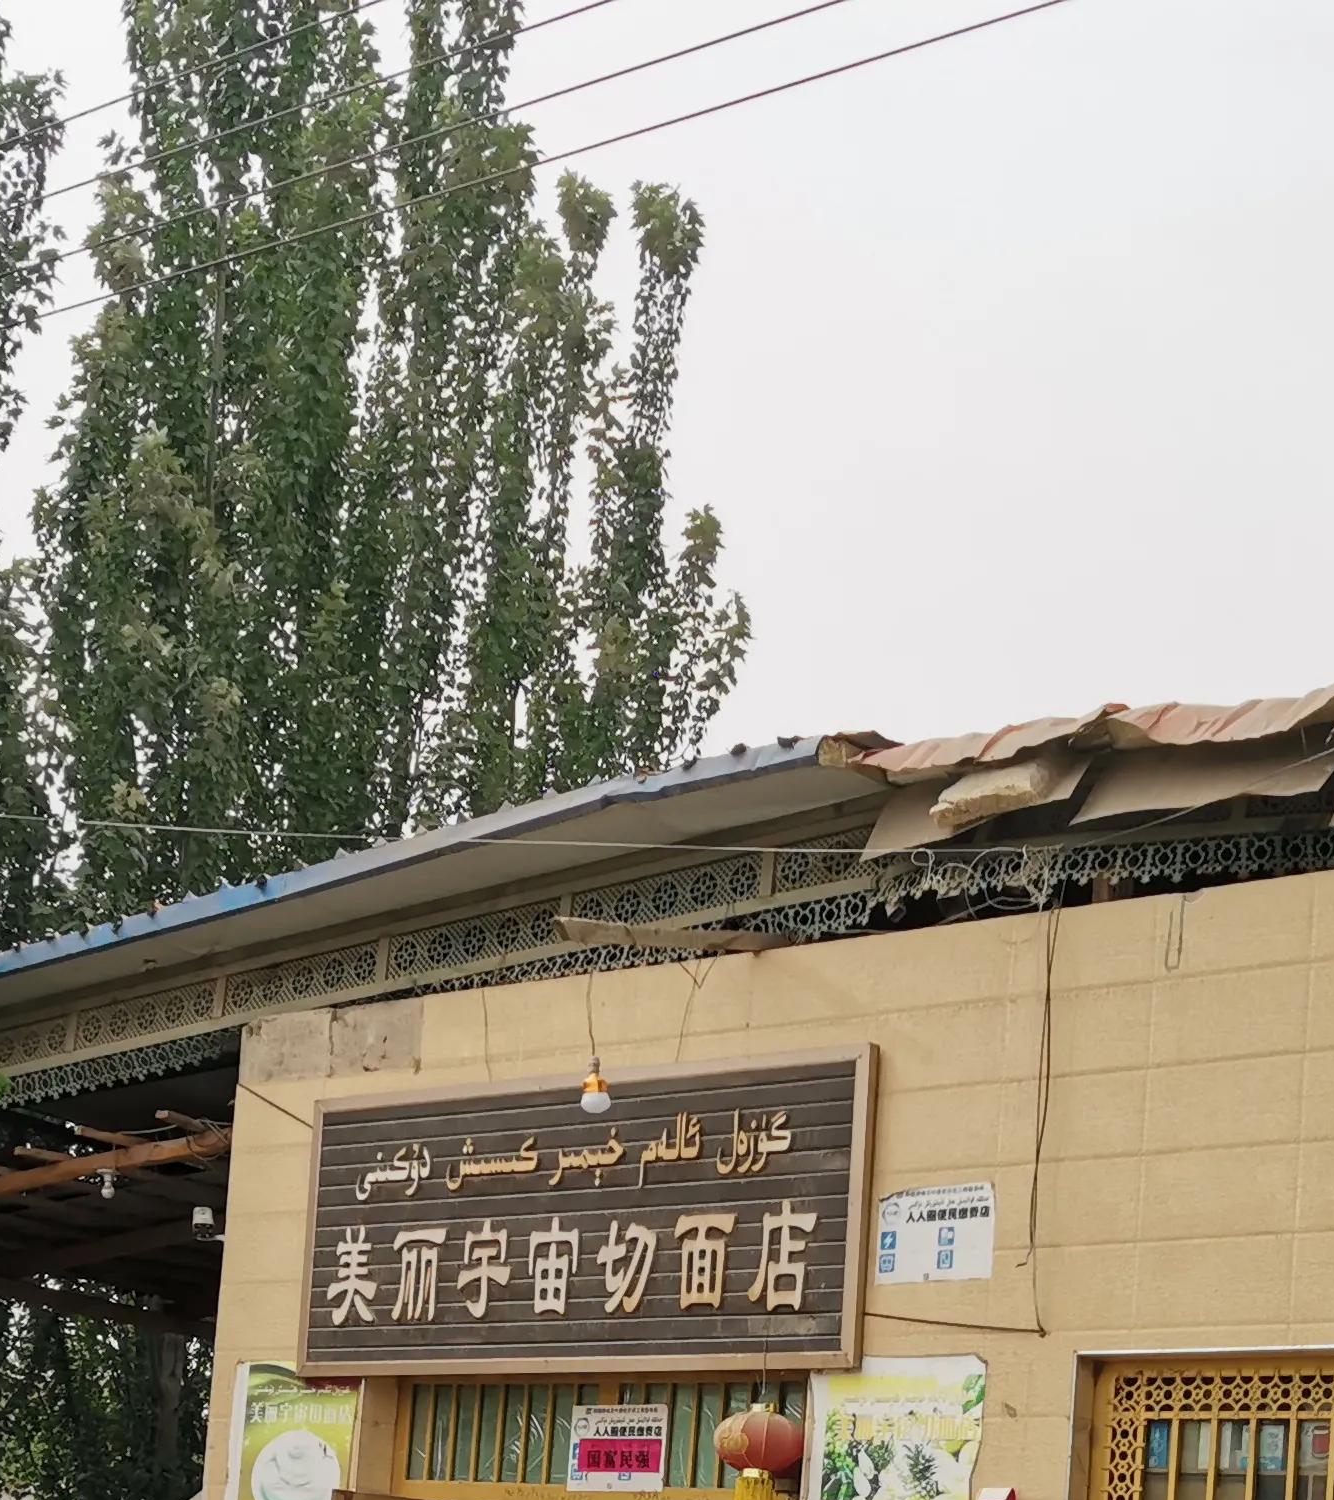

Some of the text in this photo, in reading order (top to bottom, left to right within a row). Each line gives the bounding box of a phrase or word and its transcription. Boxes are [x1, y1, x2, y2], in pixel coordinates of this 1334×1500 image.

[638, 1110, 700, 1188] ئالەم
[326, 1199, 818, 1326] 美丽宇宙切面店
[586, 1449, 651, 1468] 国富民强
